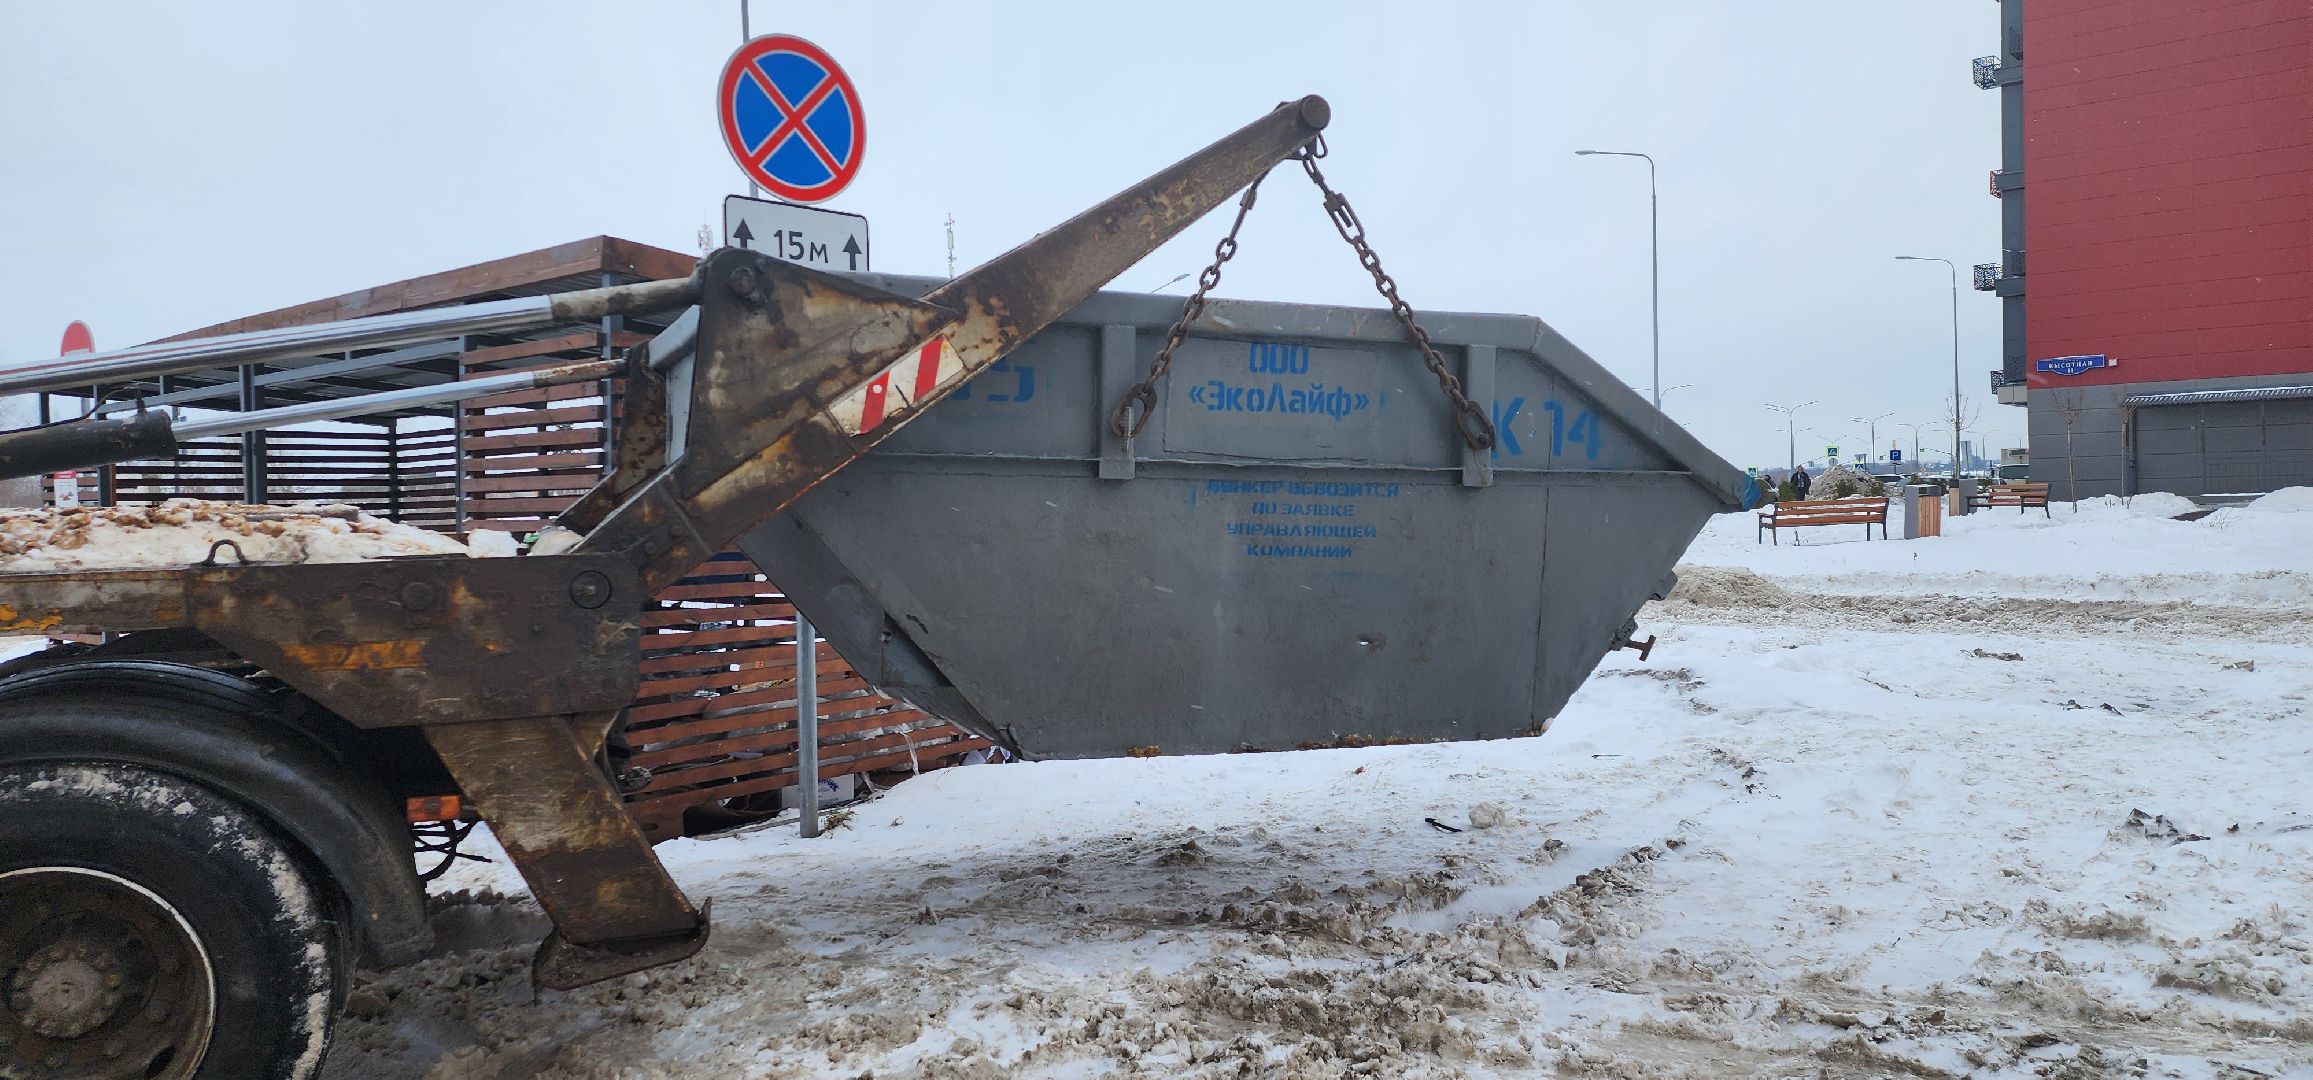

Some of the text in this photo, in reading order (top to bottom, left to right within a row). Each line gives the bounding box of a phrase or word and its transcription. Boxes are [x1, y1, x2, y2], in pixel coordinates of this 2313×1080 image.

[1249, 343, 1310, 374] ООО
[2048, 361, 2093, 369] ВЫСОТНАЯ
[1189, 380, 1370, 421] «ЭкоЛайф»
[1543, 400, 1600, 461] 14
[1287, 481, 1400, 497] ВЫВОЗИТСЯ
[1251, 502, 1355, 517] ПО ЗАЯВКЕ
[1226, 522, 1377, 538] УПРАВЛЯЮЩЕЙ
[1247, 543, 1353, 558] КОМПАНИИ
